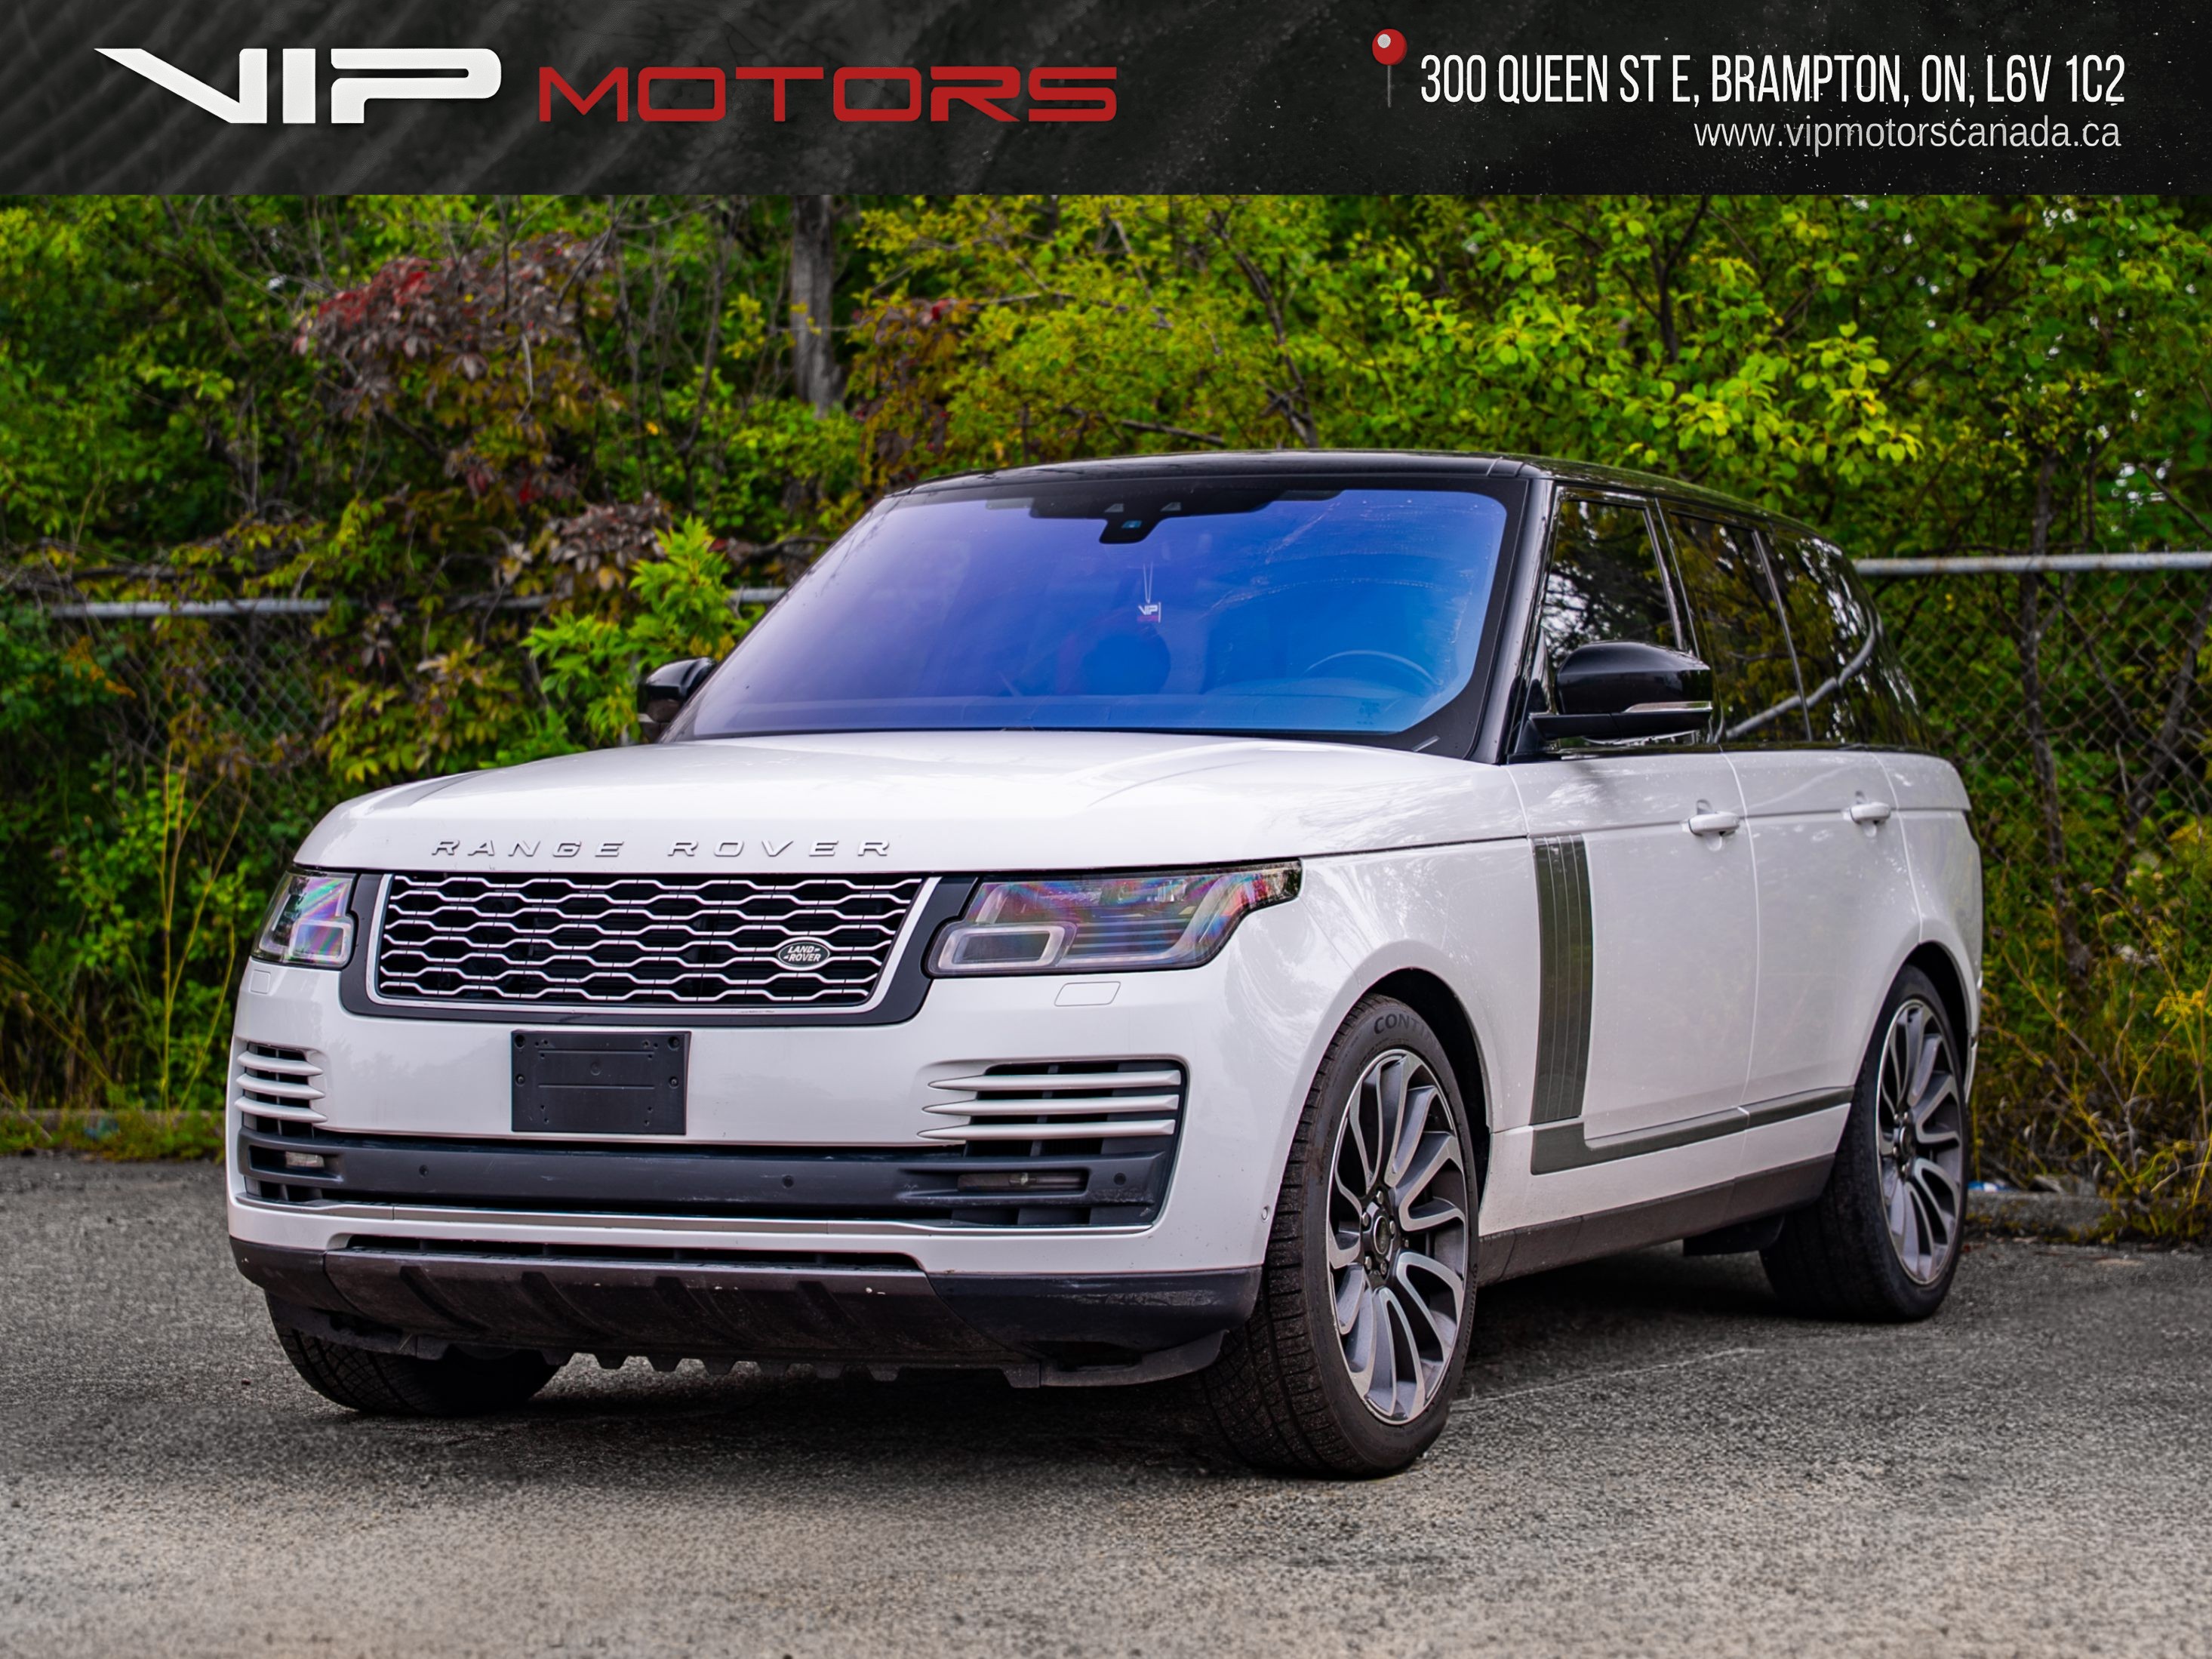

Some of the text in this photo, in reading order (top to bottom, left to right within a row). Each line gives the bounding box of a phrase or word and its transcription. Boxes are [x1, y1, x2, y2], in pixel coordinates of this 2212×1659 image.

[431, 839, 891, 858] RANGE ROVER
[787, 945, 815, 954] LAND
[787, 953, 822, 962] ROVER
